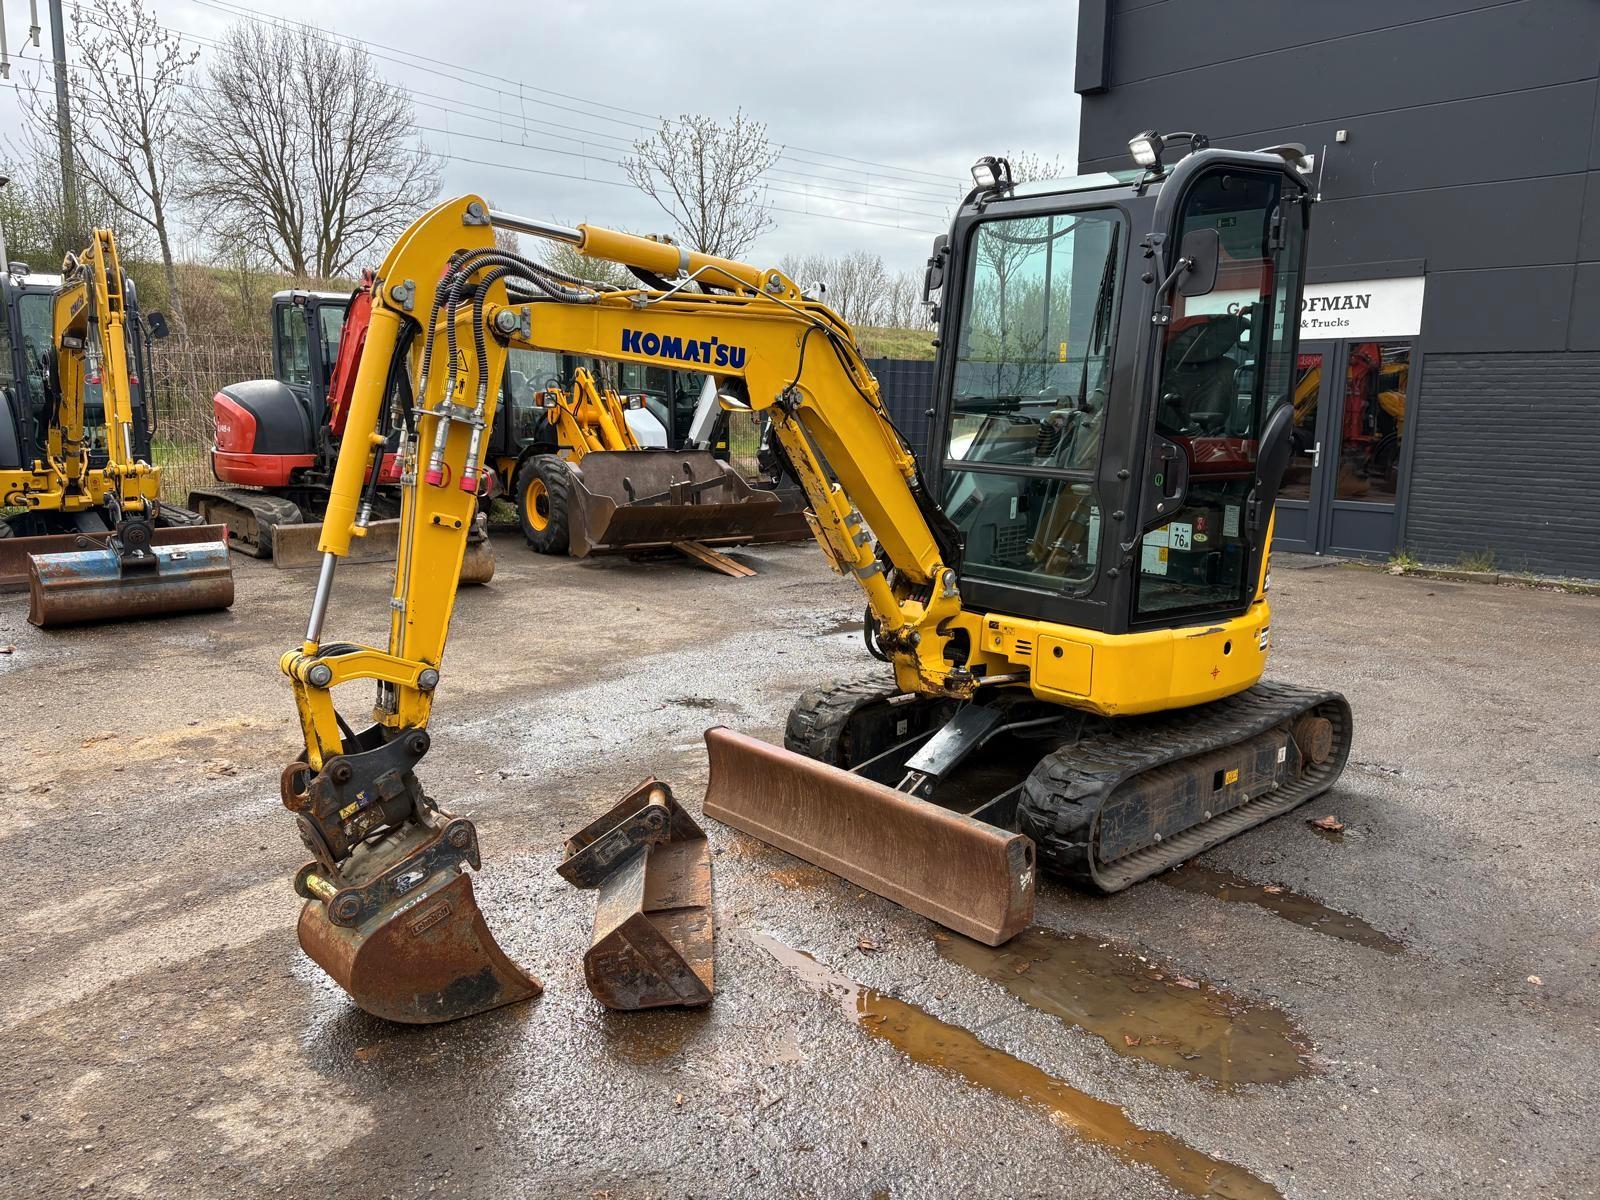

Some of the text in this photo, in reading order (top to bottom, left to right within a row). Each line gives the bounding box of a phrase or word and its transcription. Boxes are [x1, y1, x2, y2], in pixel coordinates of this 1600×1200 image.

[1310, 318, 1350, 328] Trucks
[621, 328, 746, 369] KOMATSU
[1174, 534, 1185, 547] 76
